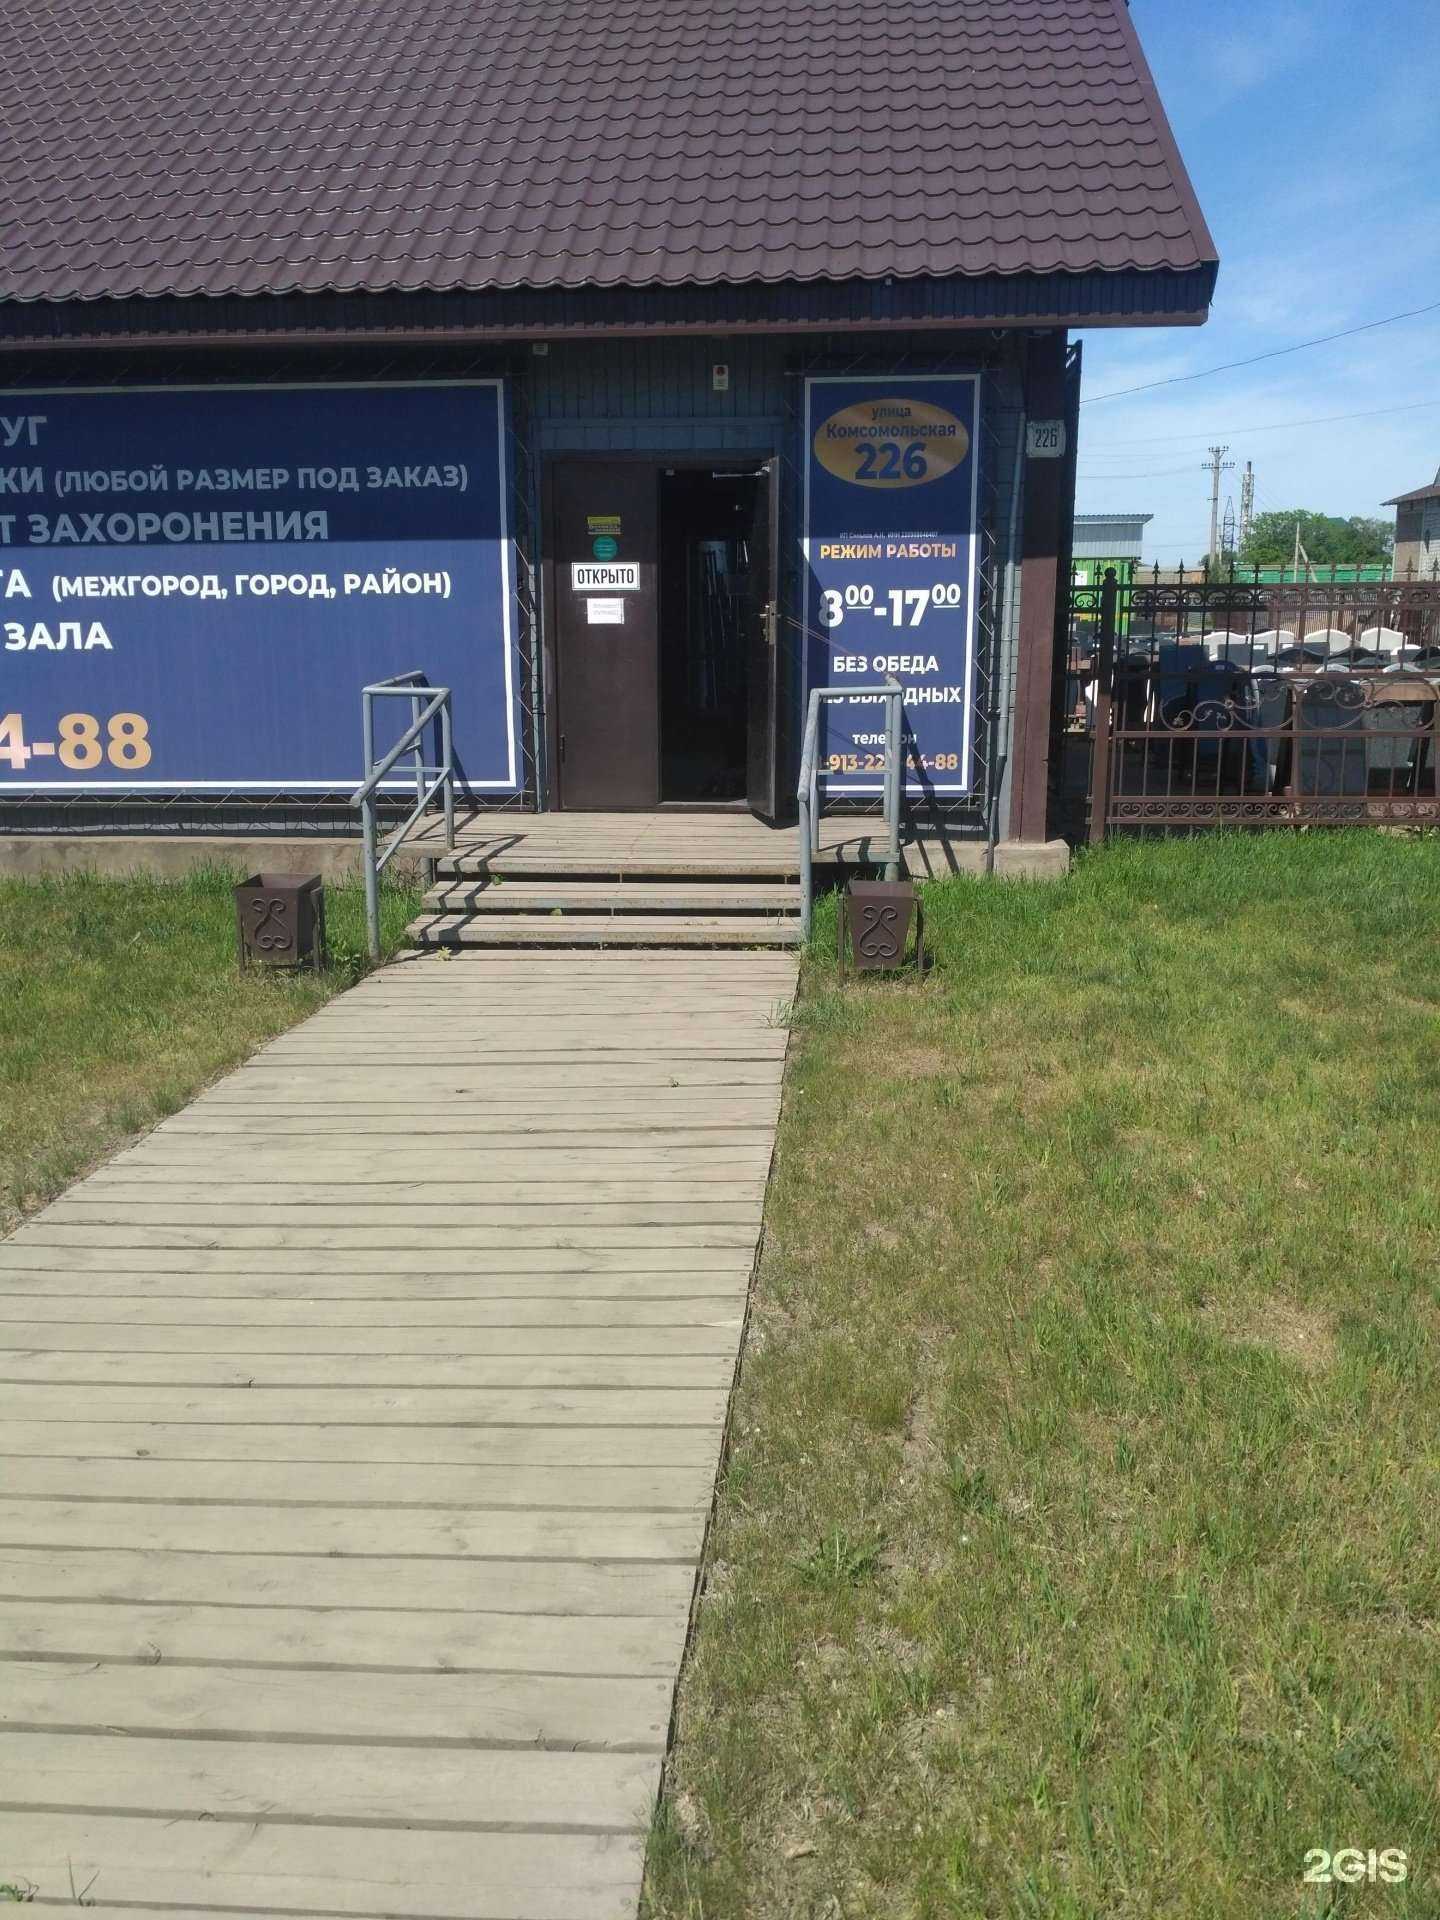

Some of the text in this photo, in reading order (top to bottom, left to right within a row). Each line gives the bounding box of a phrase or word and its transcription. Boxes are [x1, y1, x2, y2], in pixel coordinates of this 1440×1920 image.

[871, 406, 912, 421] улица
[826, 423, 957, 439] Комсомольская
[1035, 428, 1057, 448] 226
[855, 442, 928, 480] 226
[54, 464, 169, 498] (ЛЮБОЙ
[176, 468, 290, 490] РАЗМЕР
[298, 467, 360, 492] ПОД
[366, 464, 467, 491] ЗАКАЗ)
[27, 510, 328, 544] ЗАХОРОНЕНИЯ
[820, 543, 956, 559] РЕЖИМ РАБОТЫ
[0, 567, 451, 602] А (МЕЖГОРОД, ГОРОД, РАЙОН)
[577, 568, 634, 585] ОТКРЫТО
[4, 622, 113, 650] ЗАЛА
[833, 655, 939, 674] БЕЗ ОБЕДА
[852, 733, 917, 745] телеон
